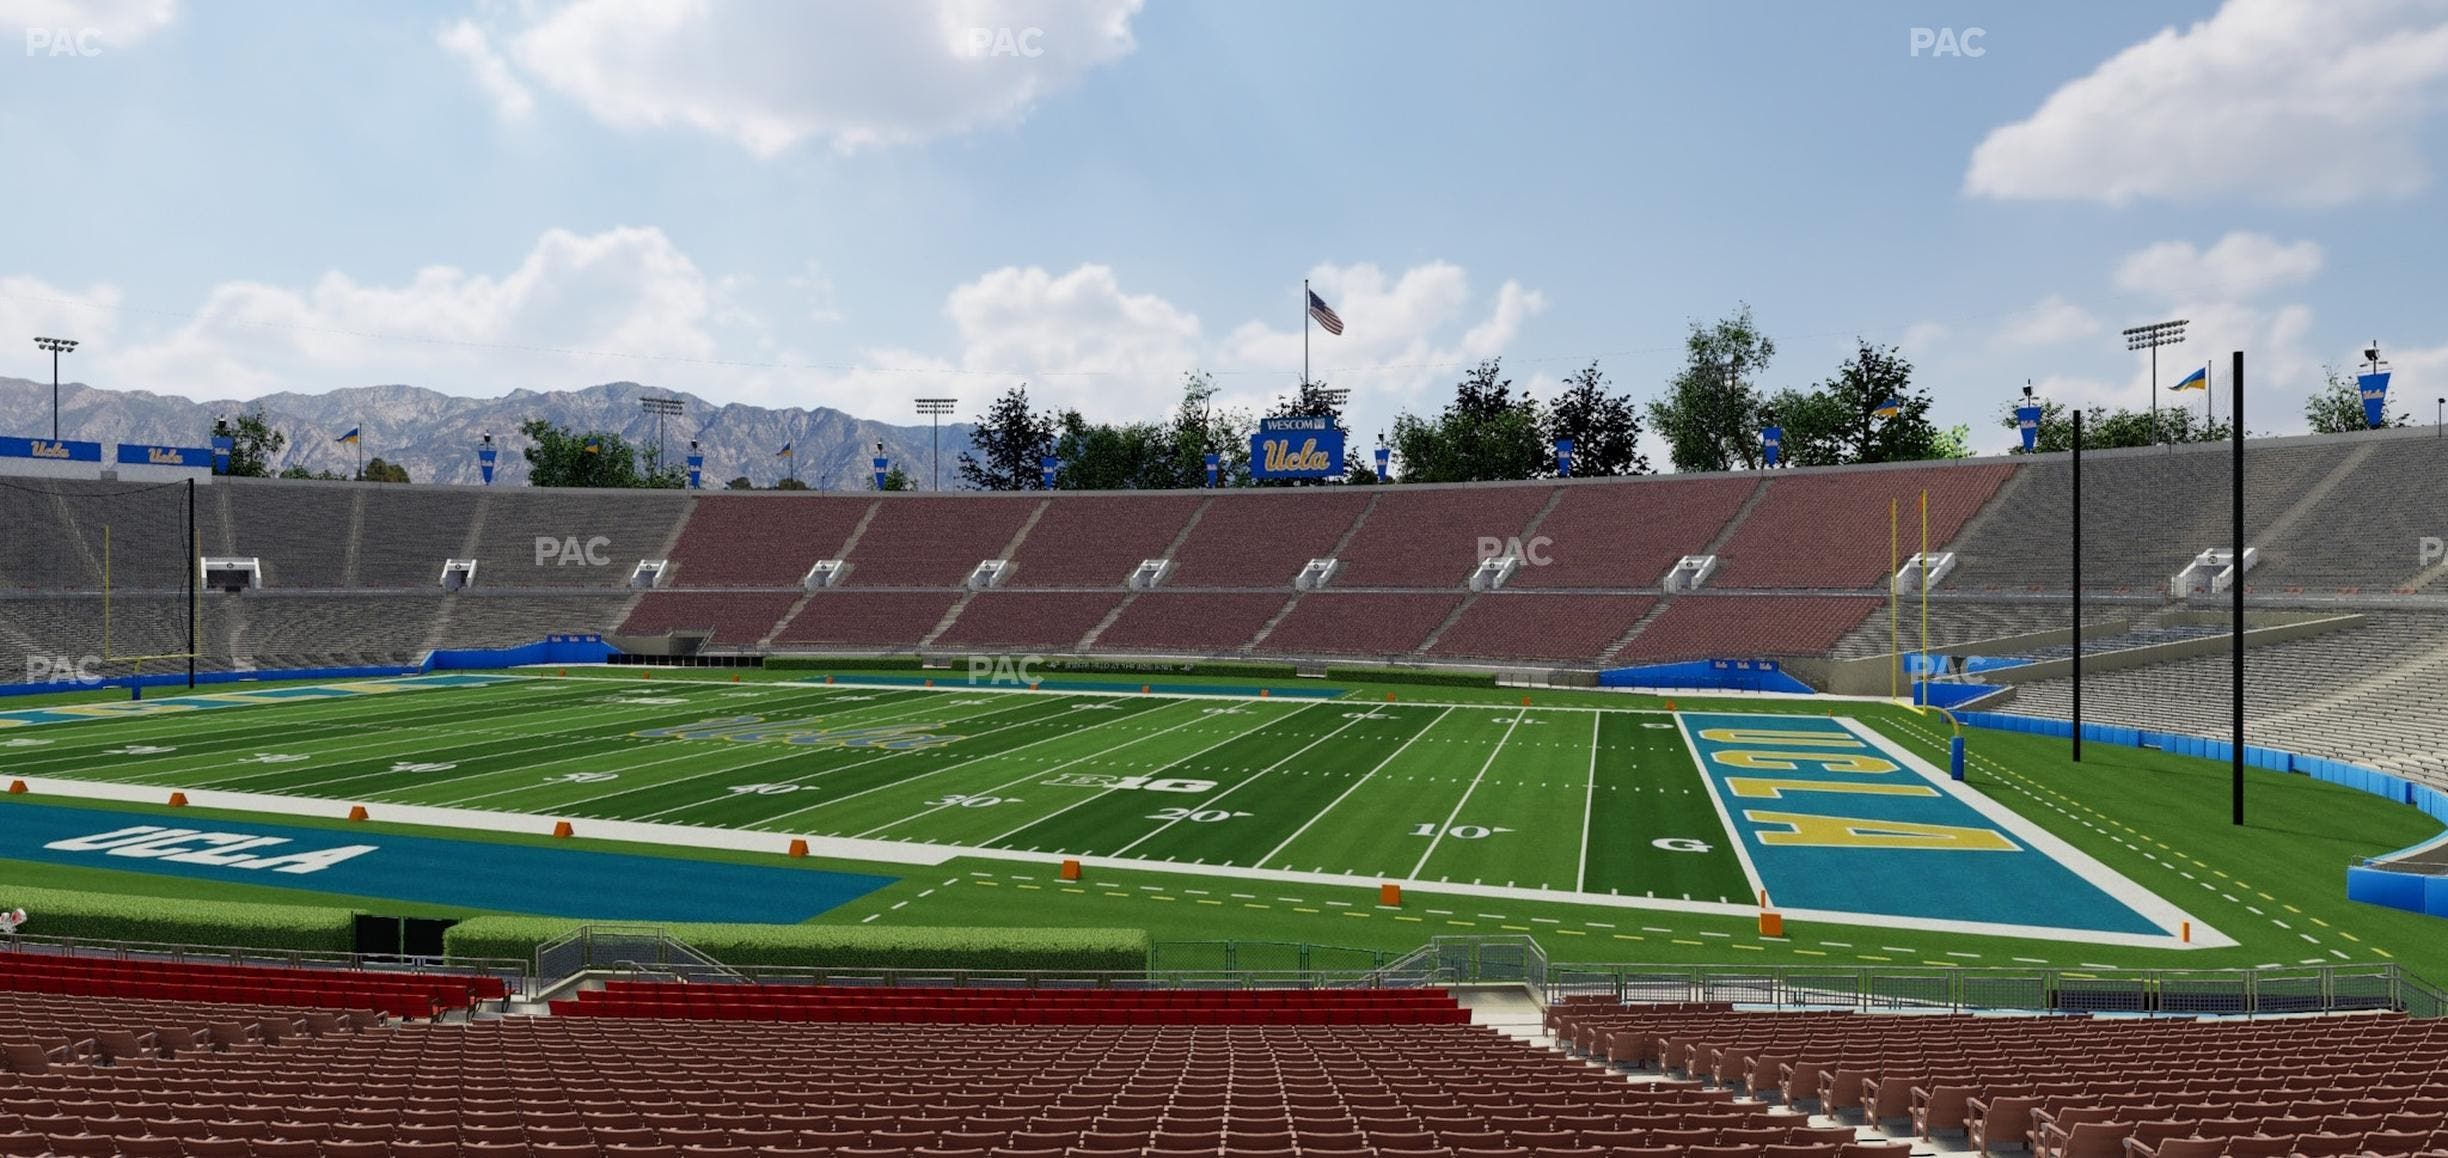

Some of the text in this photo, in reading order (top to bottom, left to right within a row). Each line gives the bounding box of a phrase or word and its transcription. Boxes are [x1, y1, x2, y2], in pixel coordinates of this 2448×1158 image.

[1267, 420, 1313, 430] WESCOM
[1263, 438, 1331, 472] Ucla
[1698, 728, 2025, 851] UCLA
[923, 794, 1002, 808] 30
[1144, 807, 1231, 822] 20
[1408, 823, 1491, 839] 10
[43, 825, 380, 874] UCLA
[1651, 837, 1714, 853] G
